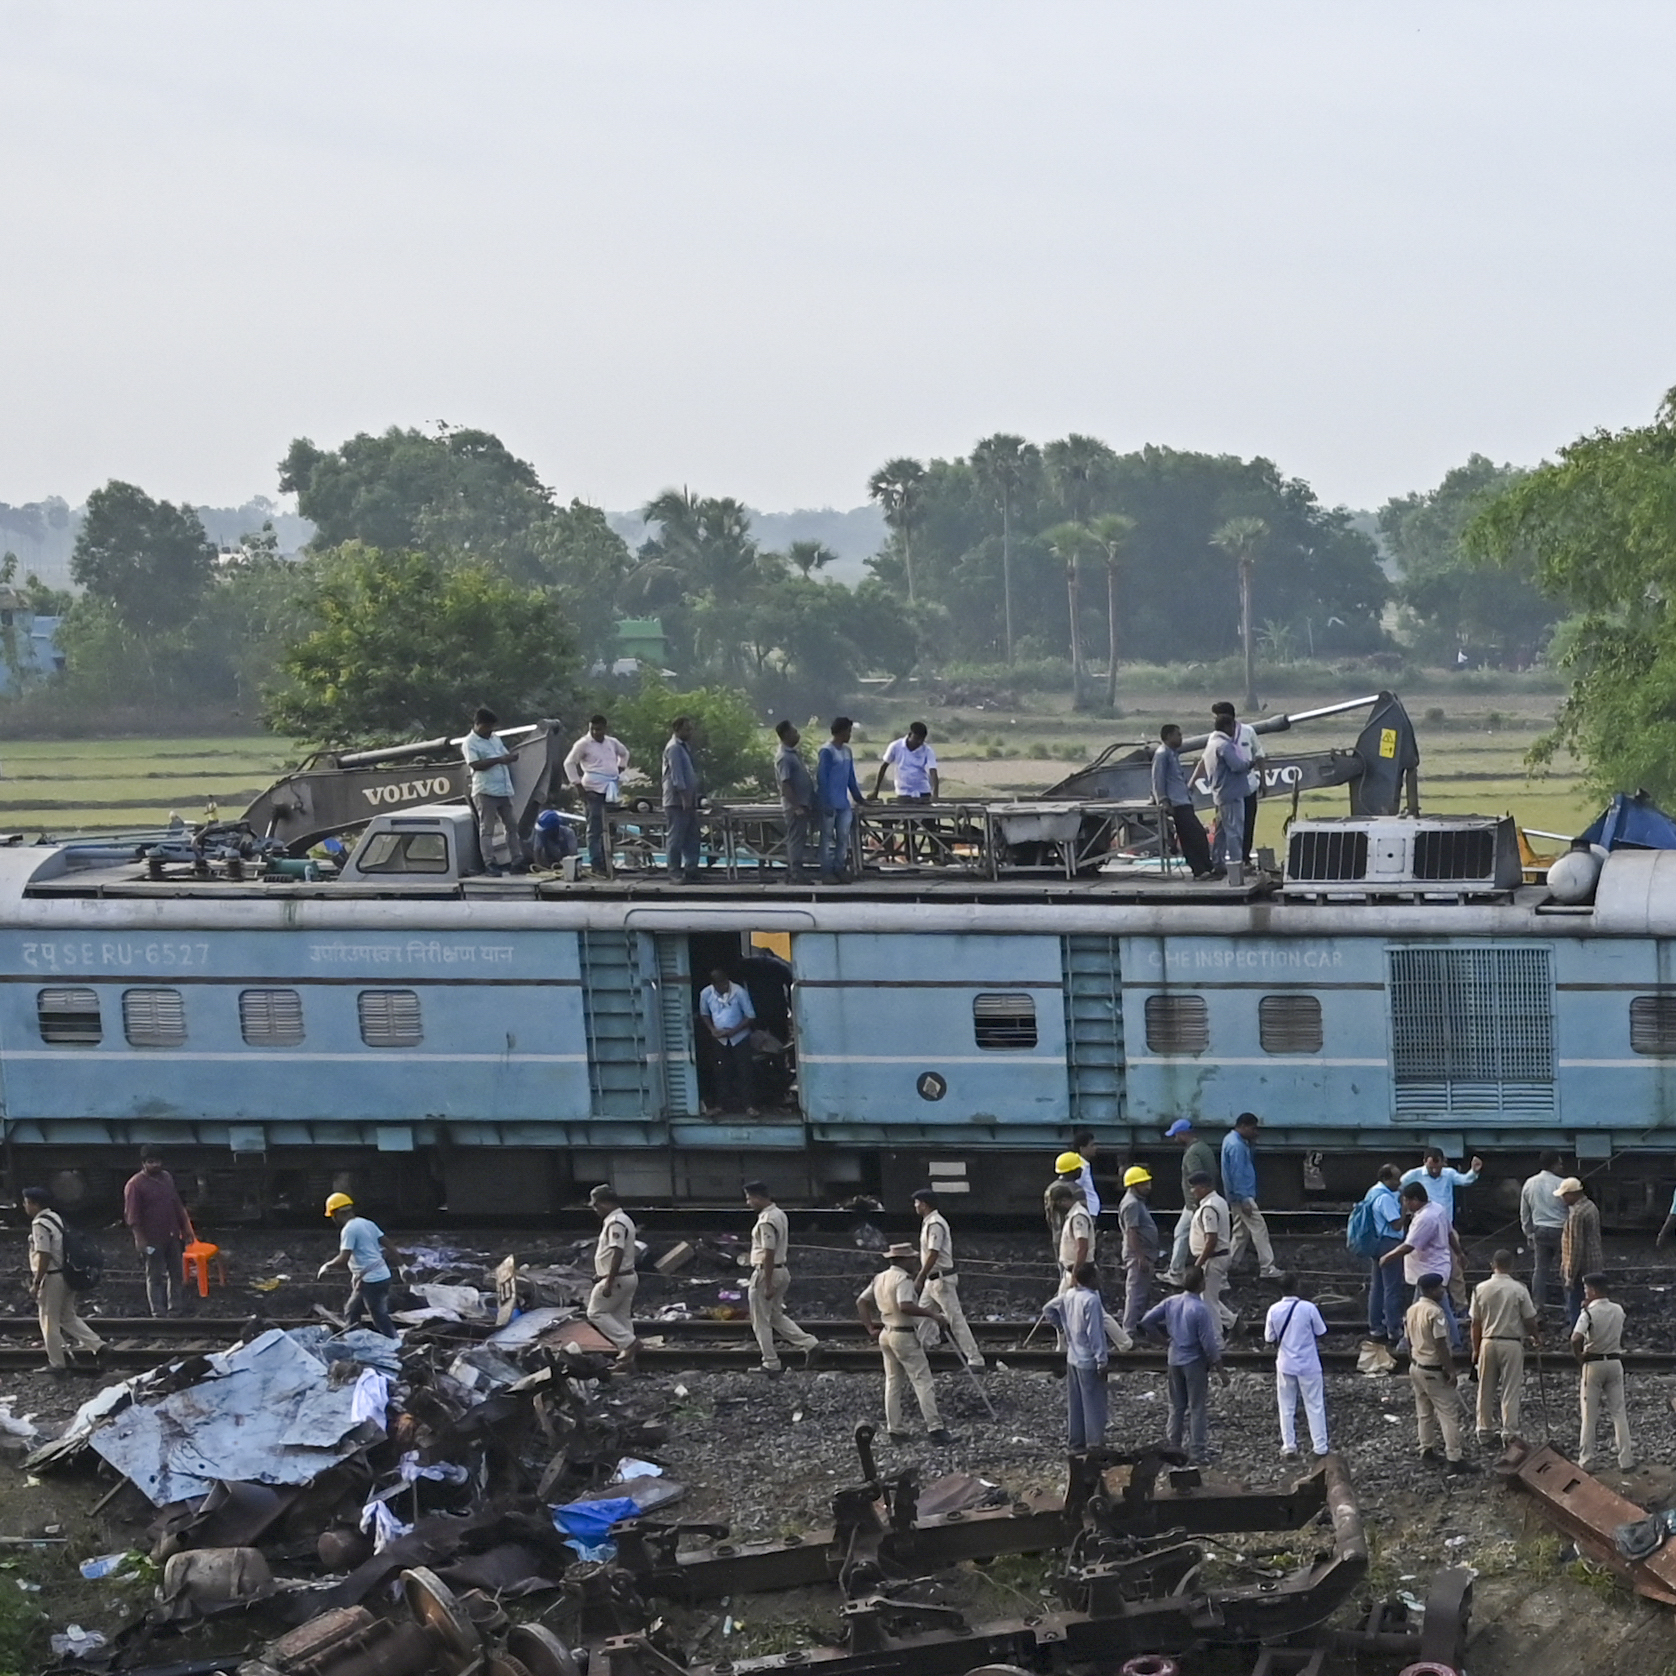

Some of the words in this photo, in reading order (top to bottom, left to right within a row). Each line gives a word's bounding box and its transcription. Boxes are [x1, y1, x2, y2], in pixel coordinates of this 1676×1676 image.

[362, 777, 450, 805] VOLVO
[479, 945, 515, 964] यान
[1195, 951, 1301, 968] INSPECTION
[1304, 951, 1343, 968] CAR
